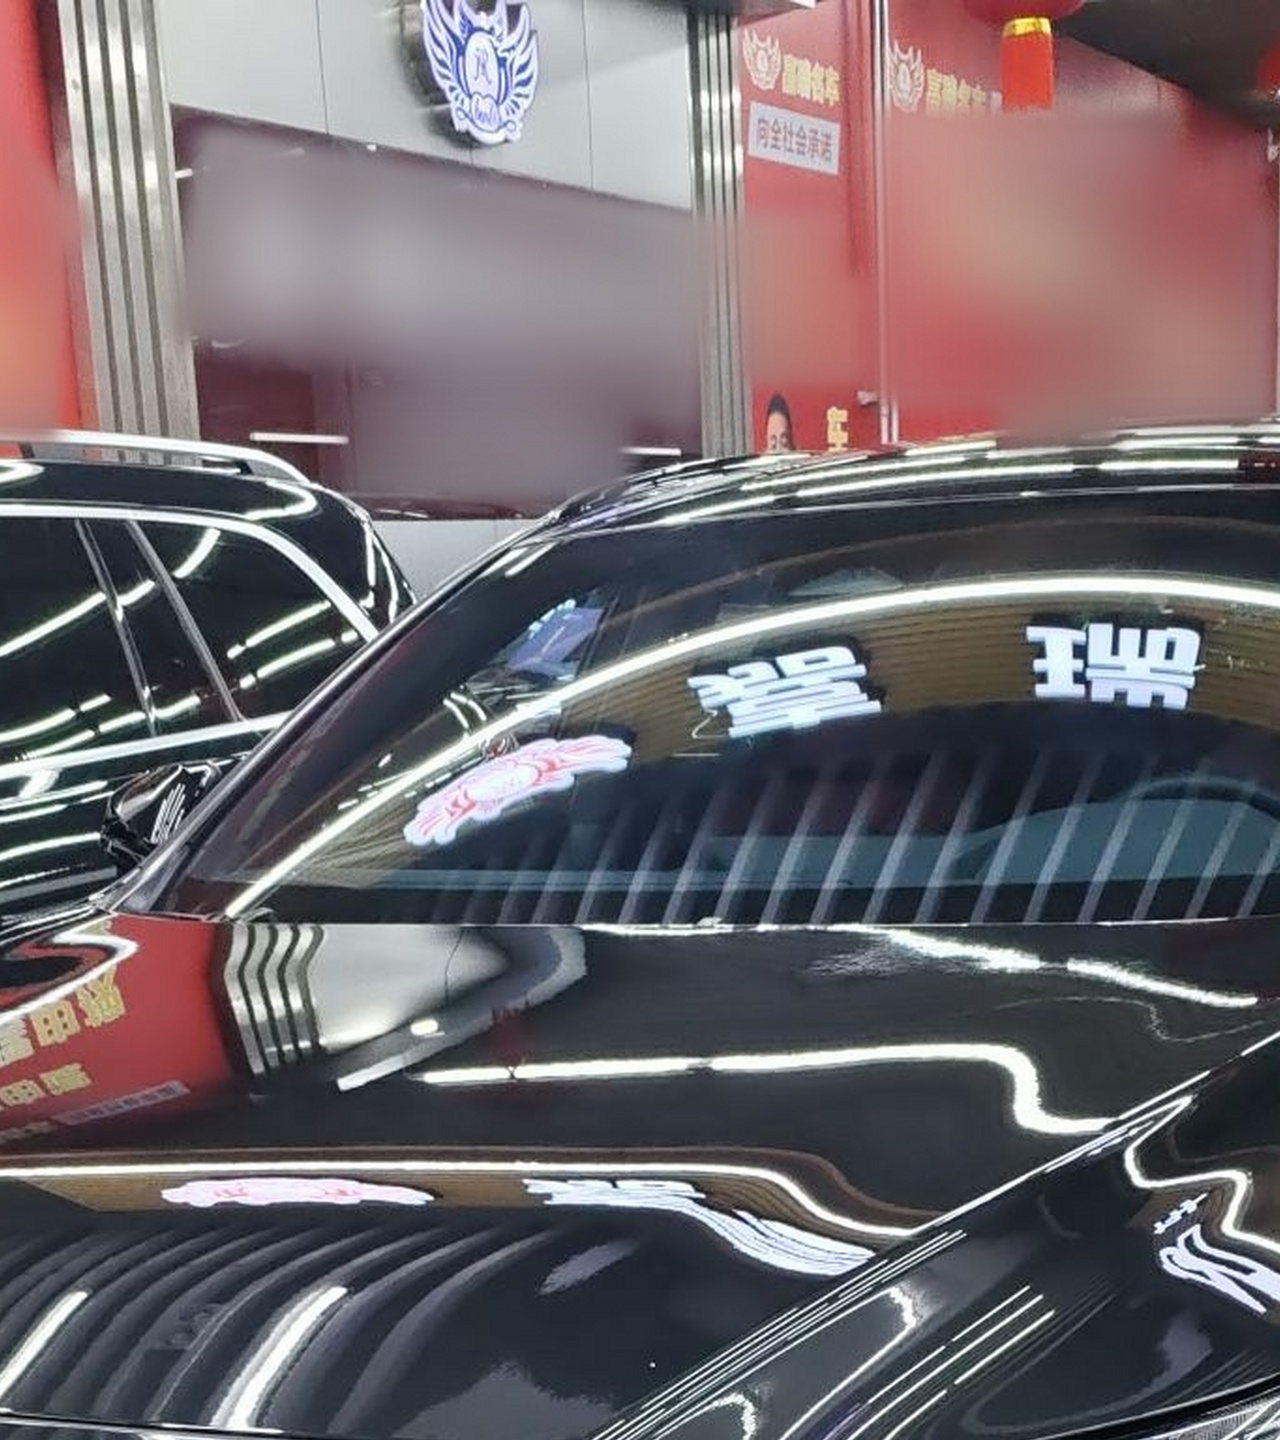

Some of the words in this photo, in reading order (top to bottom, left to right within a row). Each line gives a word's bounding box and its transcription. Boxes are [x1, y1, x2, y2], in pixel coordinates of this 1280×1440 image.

[756, 117, 833, 164] 向全社会承诺
